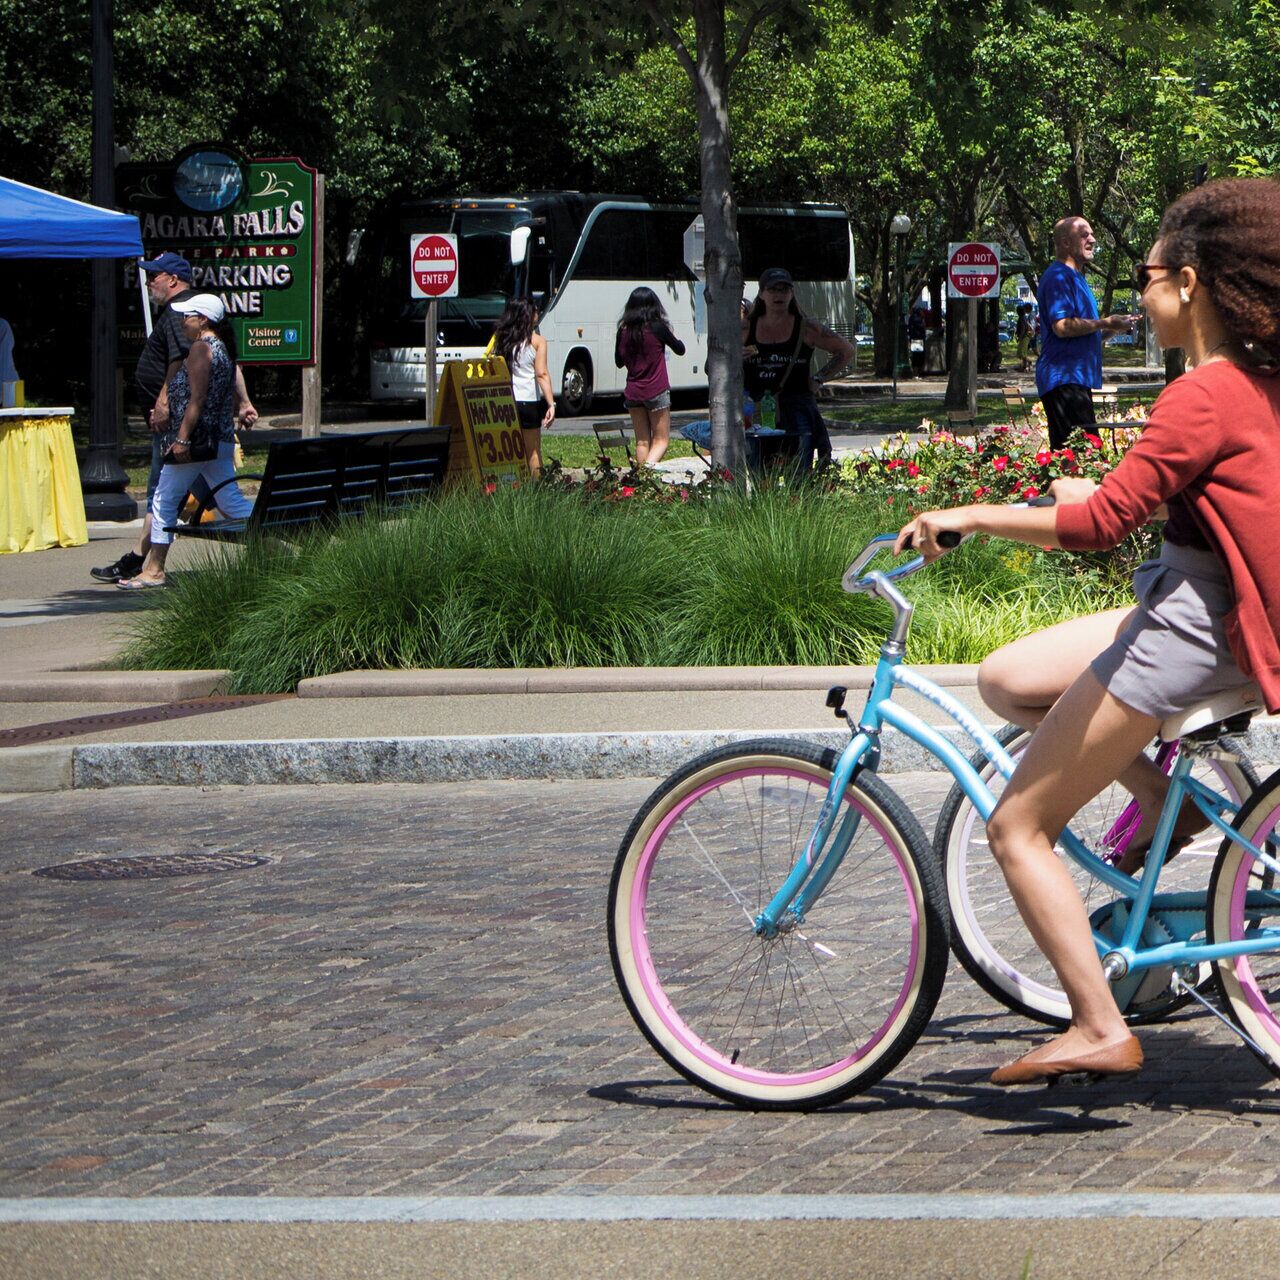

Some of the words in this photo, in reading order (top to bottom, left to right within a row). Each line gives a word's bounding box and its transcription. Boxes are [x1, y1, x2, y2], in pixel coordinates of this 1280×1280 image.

[142, 212, 227, 240] AGARA
[232, 199, 305, 239] FALLS
[214, 246, 277, 259] PARK
[419, 247, 431, 258] DO
[434, 246, 450, 258] NOT
[956, 253, 971, 264] DO
[973, 252, 992, 264] NOT
[192, 264, 292, 288] PARKING
[421, 274, 449, 285] ENTER
[958, 277, 989, 287] ENTER
[221, 291, 261, 313] ANE
[248, 327, 281, 338] Visitor
[248, 337, 281, 348] Center
[477, 429, 525, 463] $3.00
